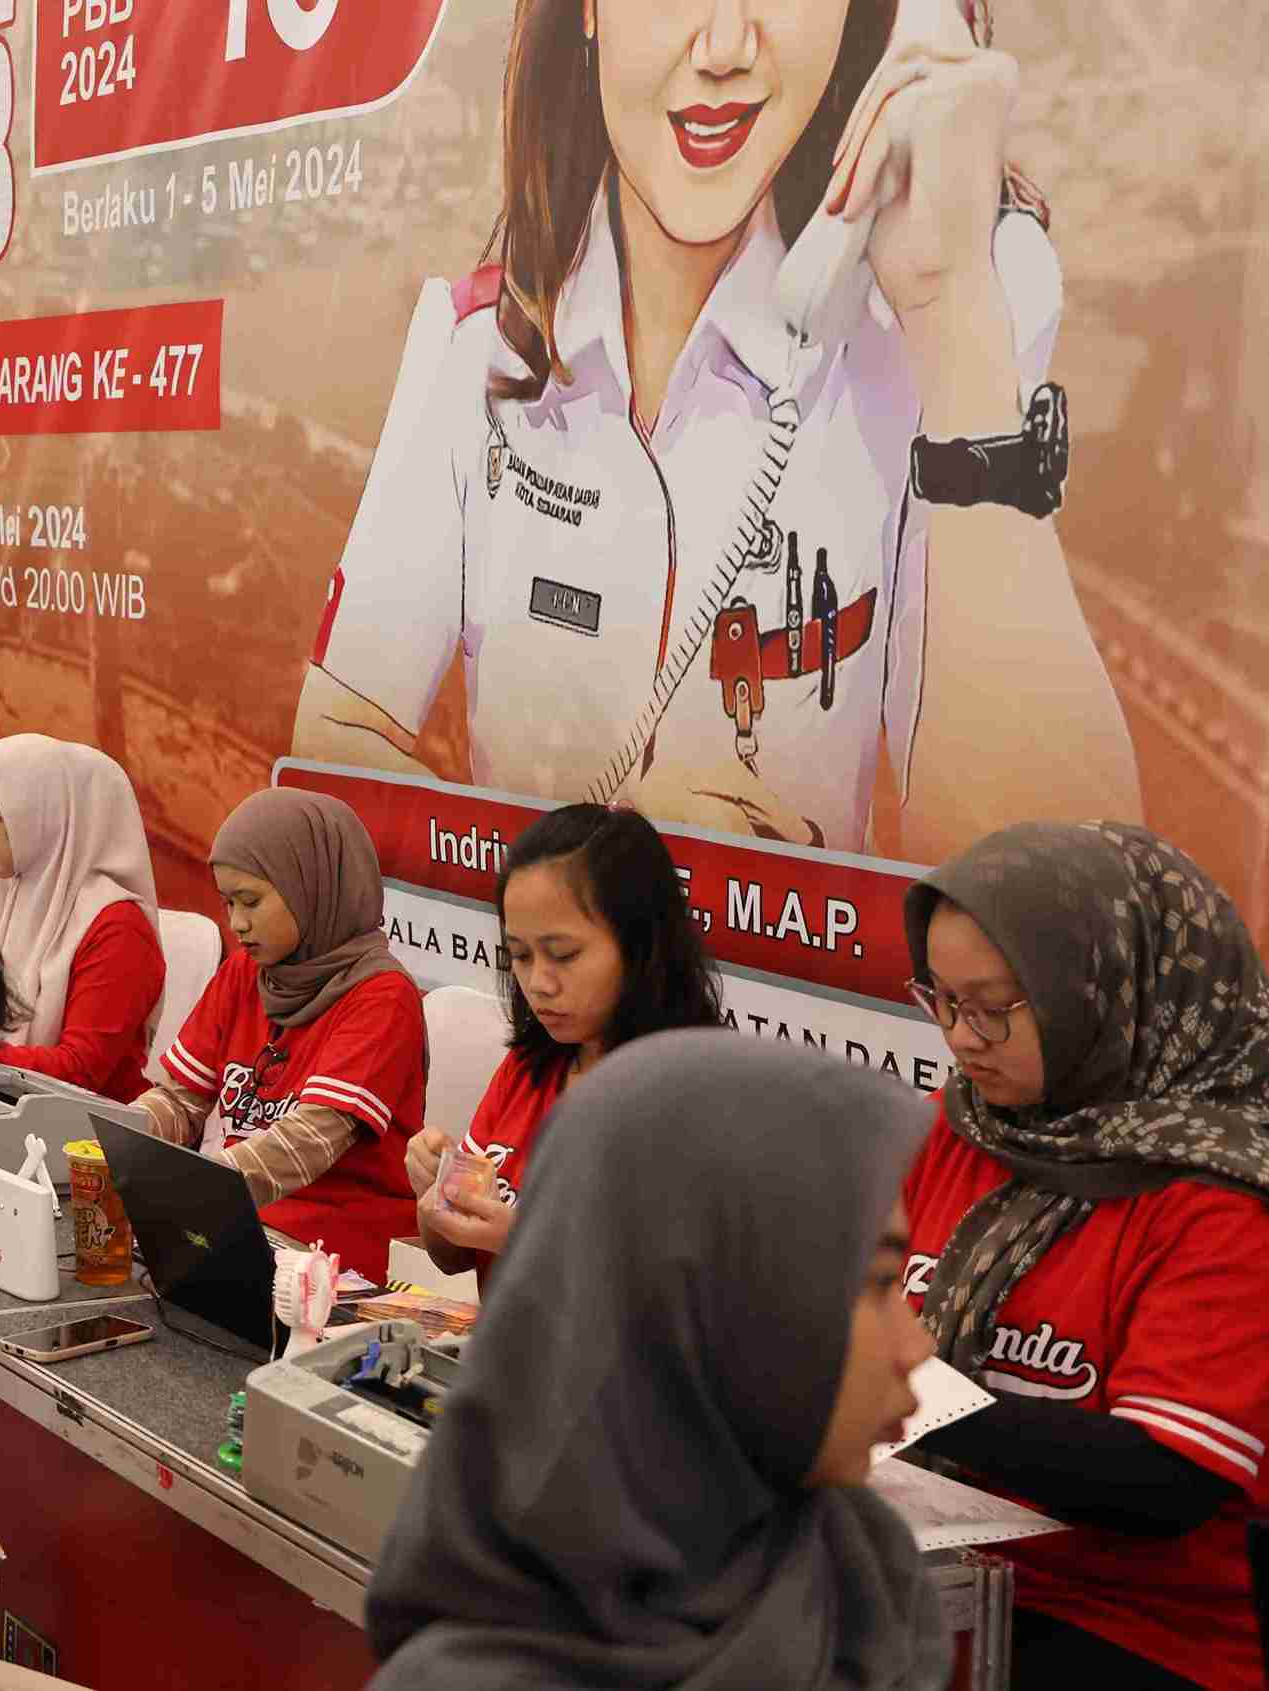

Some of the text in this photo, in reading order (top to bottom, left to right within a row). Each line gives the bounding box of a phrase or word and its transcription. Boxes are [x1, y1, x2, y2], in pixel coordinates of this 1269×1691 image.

[59, 34, 136, 105] 2024
[62, 181, 157, 236] Berlaku
[165, 172, 177, 221] 1
[201, 164, 218, 215] 5
[228, 153, 277, 211] Mei
[284, 138, 364, 201] 2024
[92, 347, 130, 400] KE
[148, 343, 204, 397] 477
[27, 504, 87, 550] 2024
[23, 566, 85, 615] 20.00
[91, 571, 147, 621] WIB
[726, 878, 863, 958] M.A.P.
[380, 914, 443, 955] ALA
[451, 932, 512, 972] BAD
[844, 1038, 955, 1093] DAE
